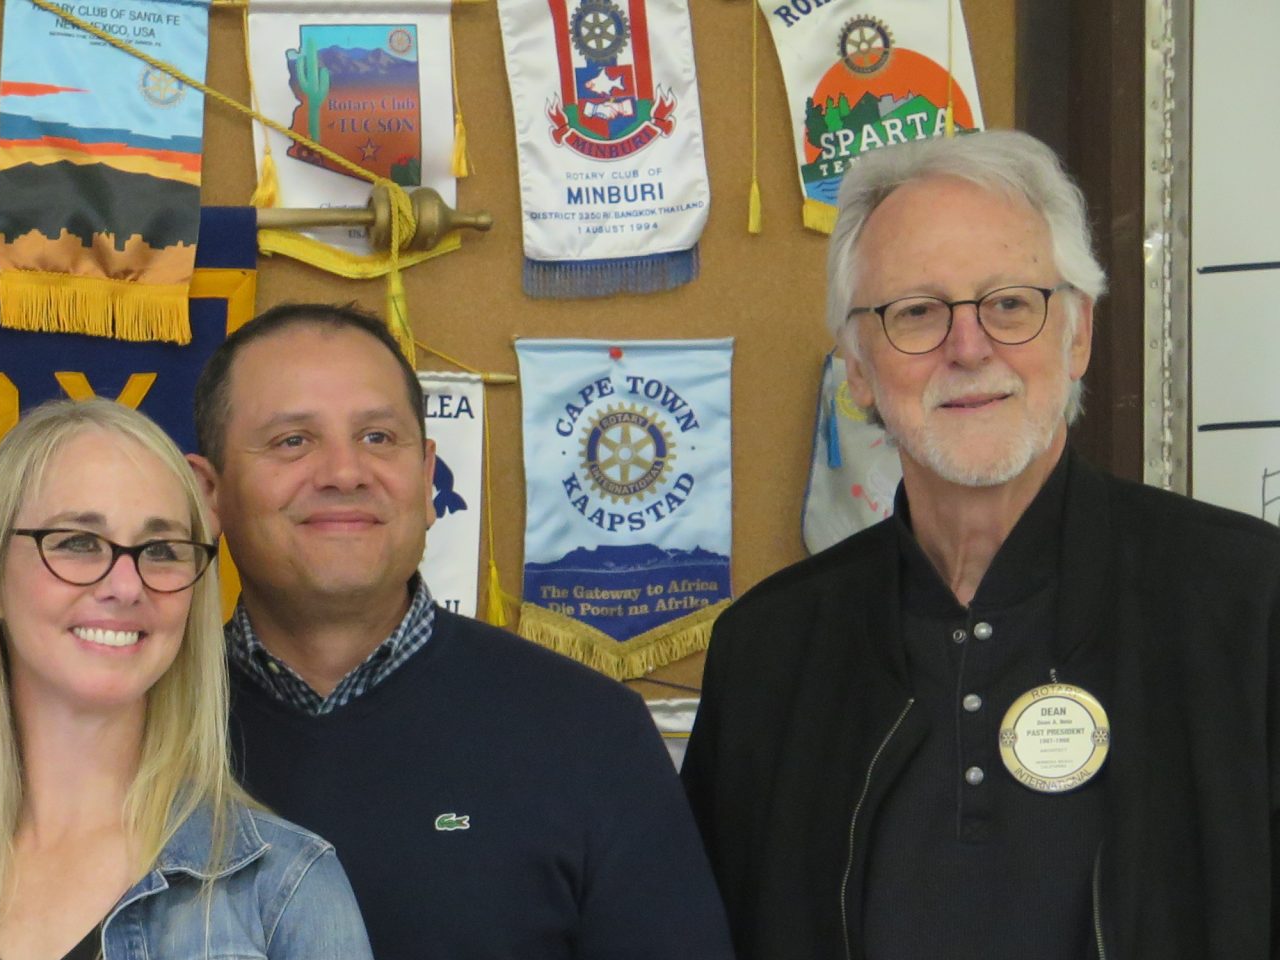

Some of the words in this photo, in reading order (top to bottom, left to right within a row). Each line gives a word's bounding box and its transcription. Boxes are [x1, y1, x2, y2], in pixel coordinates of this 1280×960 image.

[78, 5, 108, 18] CLUB
[111, 8, 126, 20] OF
[129, 11, 163, 25] SANTA
[167, 14, 181, 26] FE
[133, 24, 156, 38] USA
[328, 98, 376, 112] Rotary
[381, 97, 416, 110] Club
[339, 117, 415, 133] TUCSON
[819, 108, 959, 160] SPARTA
[573, 130, 655, 158] MINBURI
[566, 171, 605, 181] ROTARY
[611, 170, 639, 180] CLUB
[648, 168, 663, 176] OF
[567, 182, 664, 205] MINBURI
[530, 211, 576, 221] DISTRICT
[614, 209, 656, 219] BANGKOK
[658, 201, 704, 215] THAILAND
[585, 225, 625, 234] AUGUST
[630, 222, 658, 232] 1994
[424, 394, 475, 419] LEA
[555, 376, 614, 437] CAPE
[626, 376, 700, 433] TOWN
[601, 413, 646, 428] ROTARY
[590, 463, 663, 494] INTERNATIONAL
[562, 472, 695, 532] KAAPSTAD
[540, 585, 569, 598] The
[573, 585, 641, 602] Gateway
[646, 583, 664, 596] to
[669, 580, 718, 594] Africa
[548, 602, 574, 616] Die
[579, 603, 624, 616] Poort
[628, 604, 649, 616] na
[655, 596, 709, 612] Afrika
[1031, 684, 1082, 699] ROTARY
[1041, 707, 1067, 717] DEAN
[1026, 729, 1044, 737] PAST
[1046, 727, 1085, 737] PRESIDENT
